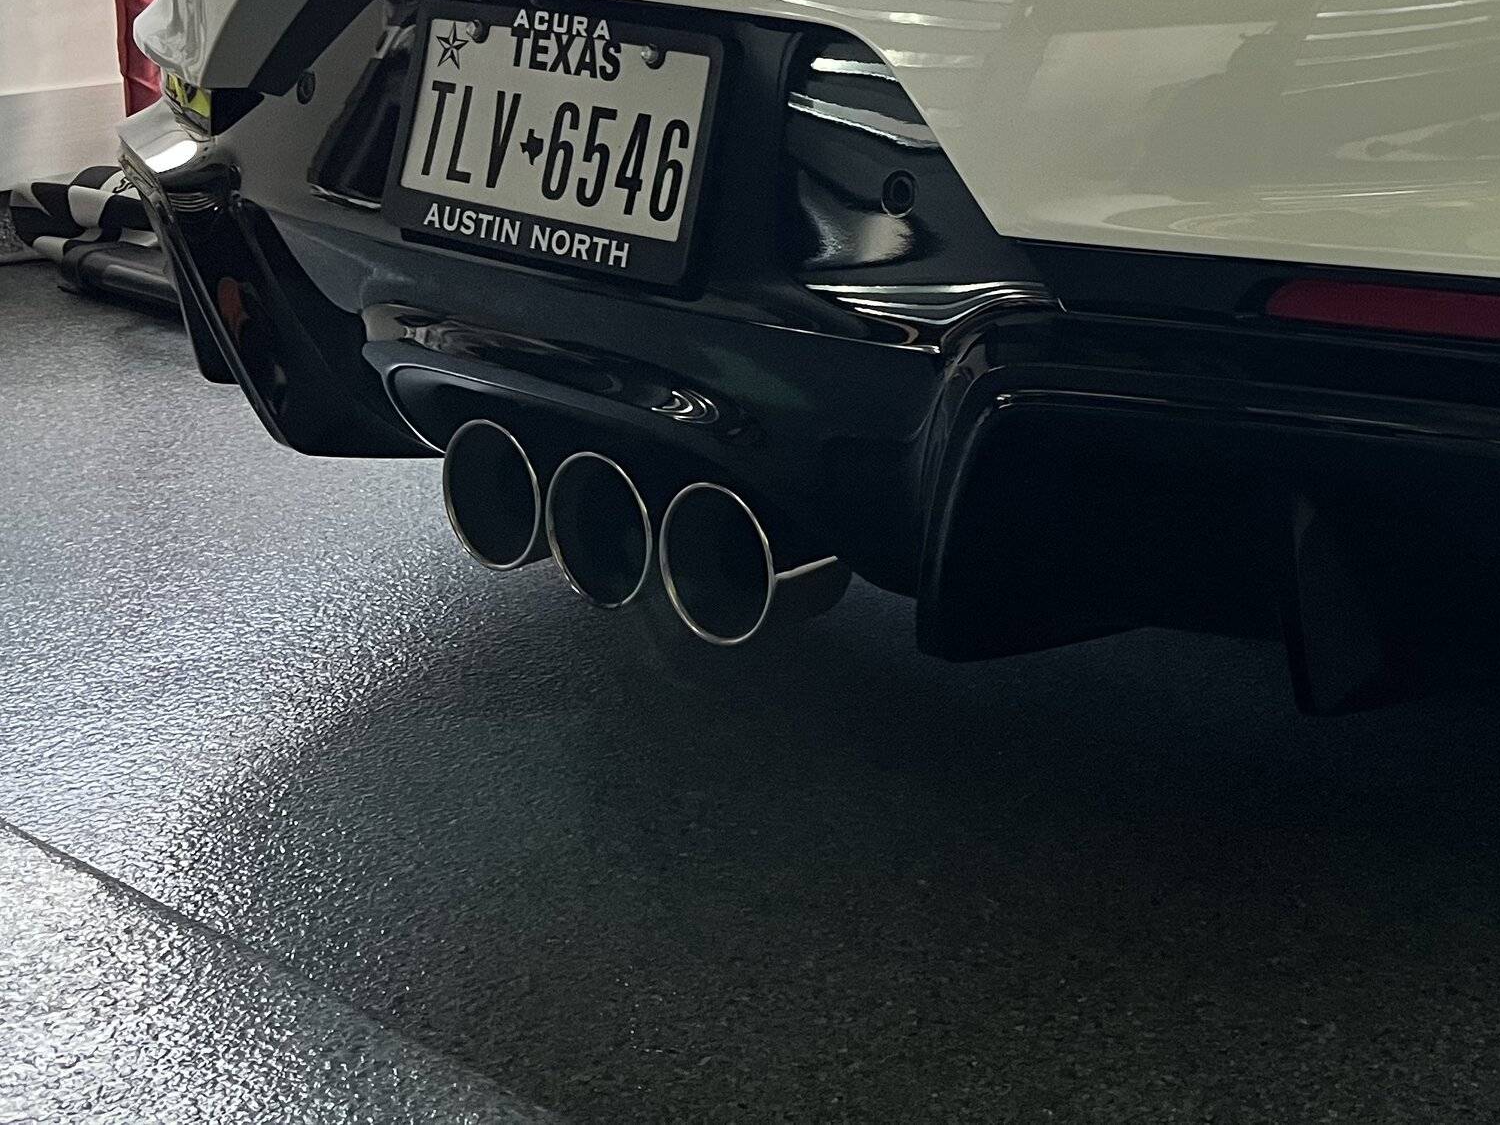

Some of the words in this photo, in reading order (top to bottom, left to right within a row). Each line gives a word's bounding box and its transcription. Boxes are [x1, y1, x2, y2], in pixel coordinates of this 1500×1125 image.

[513, 8, 611, 41] ACURA
[510, 30, 623, 82] TEXAS
[423, 202, 522, 245] AUSTIN
[529, 224, 630, 268] NORTH
